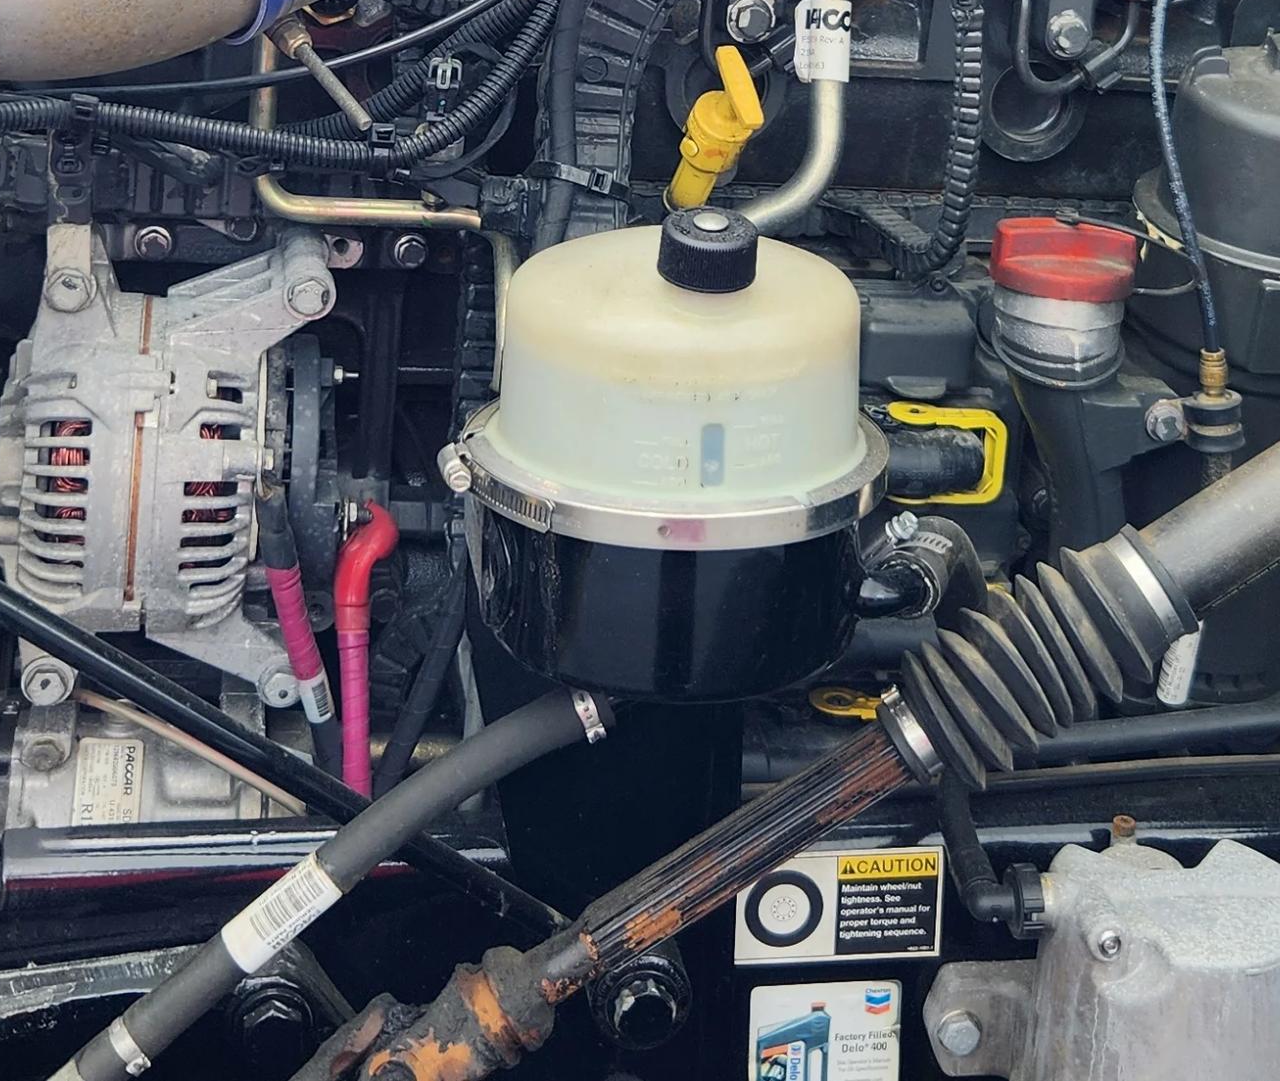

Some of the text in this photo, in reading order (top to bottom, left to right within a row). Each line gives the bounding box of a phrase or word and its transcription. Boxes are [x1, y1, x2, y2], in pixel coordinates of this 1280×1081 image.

[122, 746, 136, 796] PACCAR
[857, 857, 936, 874] CAUTION
[841, 882, 923, 893] Maintain wheel/nut
[841, 894, 902, 905] tightness. See
[840, 904, 931, 916] operator's manual for
[840, 920, 868, 928] proper
[870, 918, 898, 926] torque
[840, 928, 927, 939] tightening sequence.
[834, 1032, 866, 1041] Factory
[870, 1041, 888, 1051] 400
[789, 1057, 801, 1080] Delo
